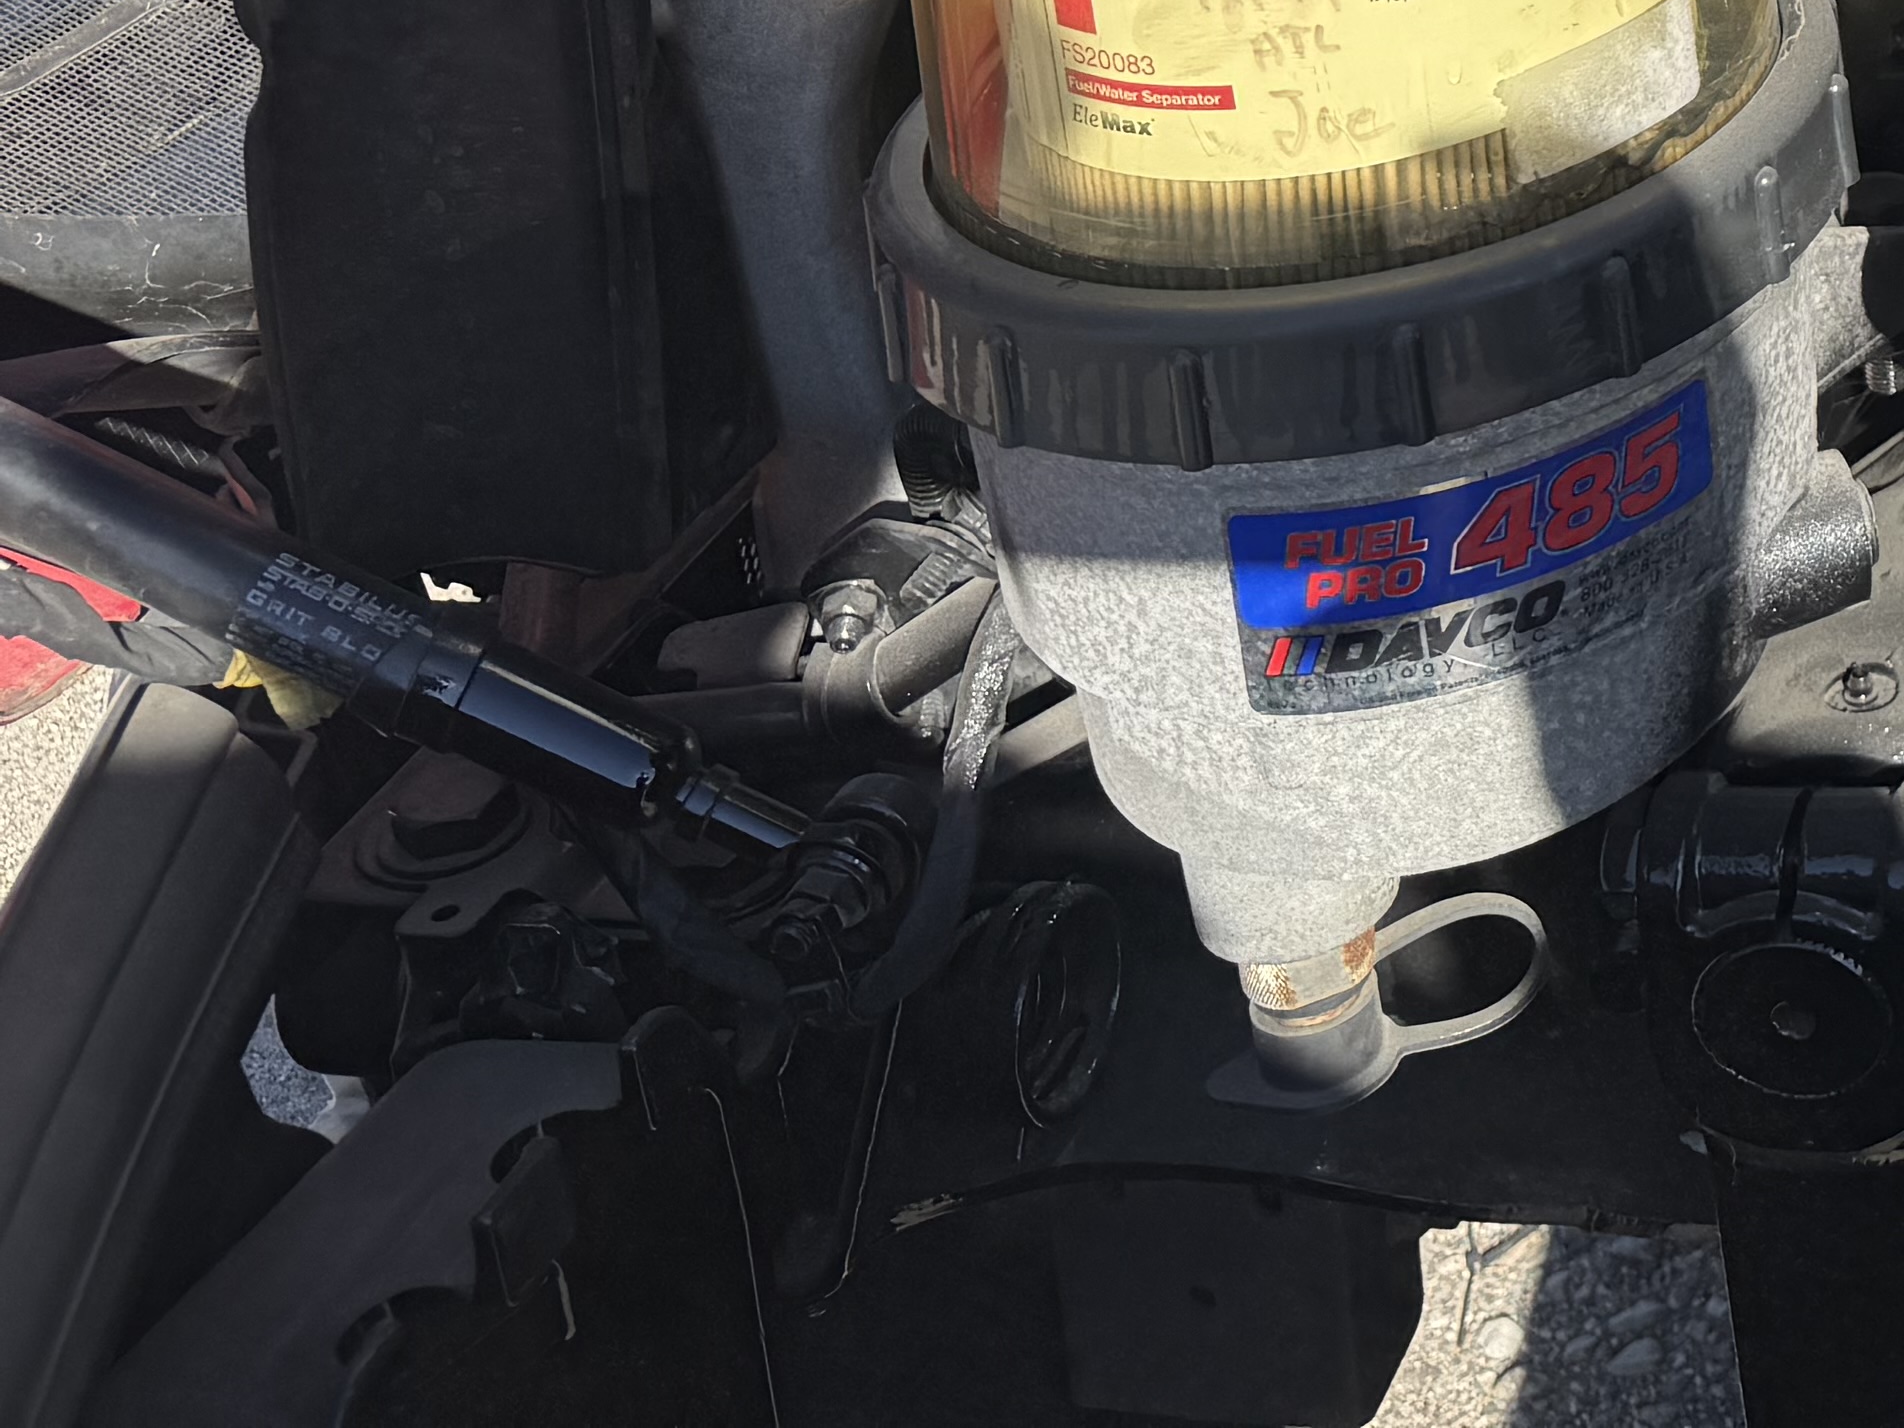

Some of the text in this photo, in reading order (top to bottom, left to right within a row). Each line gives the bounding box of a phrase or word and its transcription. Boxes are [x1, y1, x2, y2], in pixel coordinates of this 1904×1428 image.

[1060, 40, 1156, 76] FS20083
[1251, 24, 1342, 72] ATL
[1067, 75, 1222, 107] Fuel/Water Separator
[1072, 102, 1153, 137] EleMax
[1268, 89, 1396, 158] Joe
[1284, 517, 1429, 570] FUEL
[1450, 403, 1686, 578] 485
[276, 552, 423, 627] STABILUS
[1306, 557, 1426, 610] PRO
[1325, 578, 1568, 675] DAVCO
